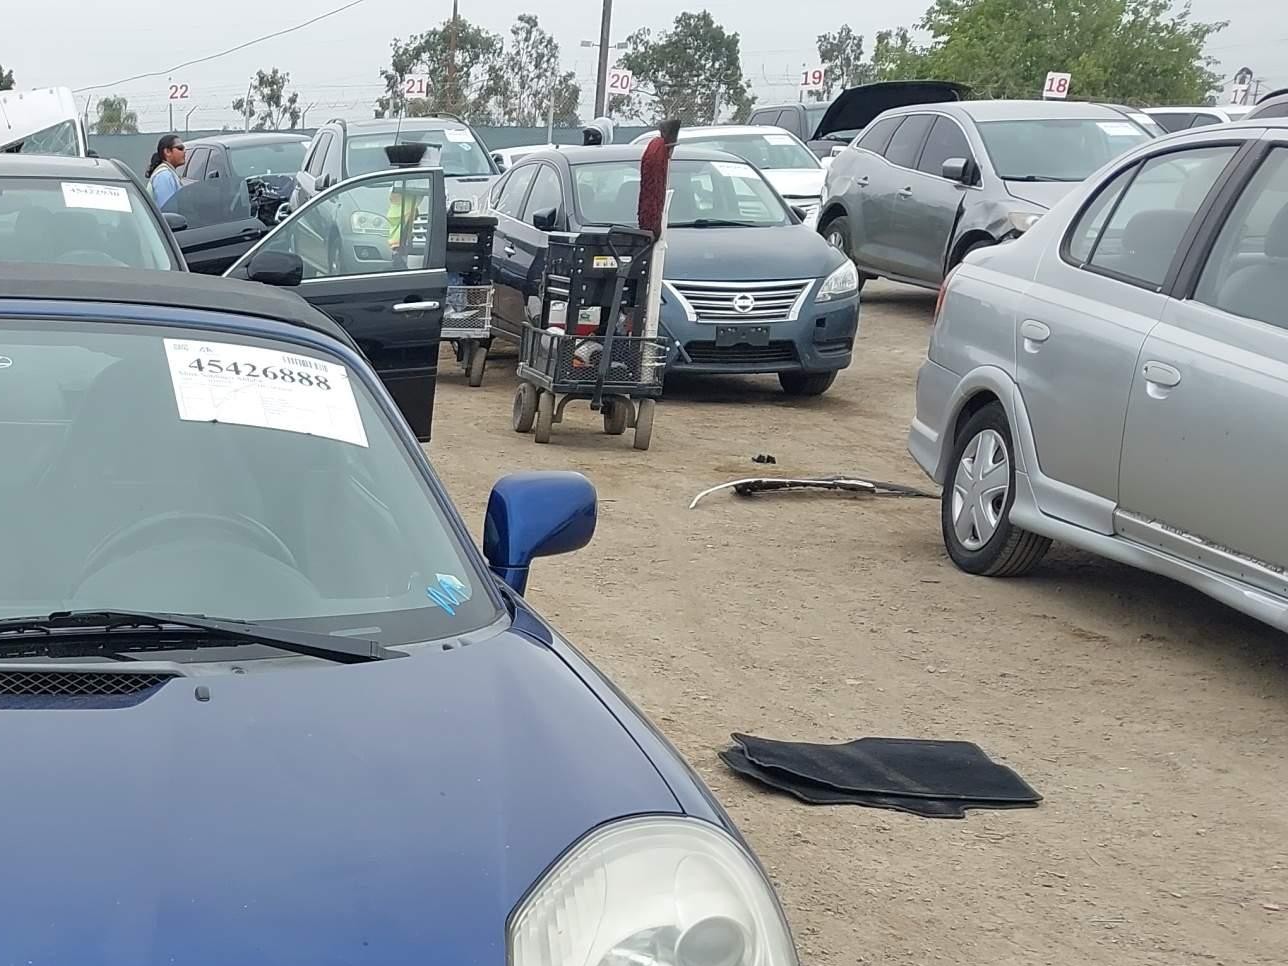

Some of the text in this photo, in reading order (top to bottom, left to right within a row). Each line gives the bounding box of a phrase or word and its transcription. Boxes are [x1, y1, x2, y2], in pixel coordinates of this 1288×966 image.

[609, 73, 630, 90] 20
[801, 70, 823, 86] 19
[1046, 77, 1068, 93] 18
[169, 84, 189, 99] 22
[405, 79, 425, 94] 21
[187, 357, 333, 391] 45426888
